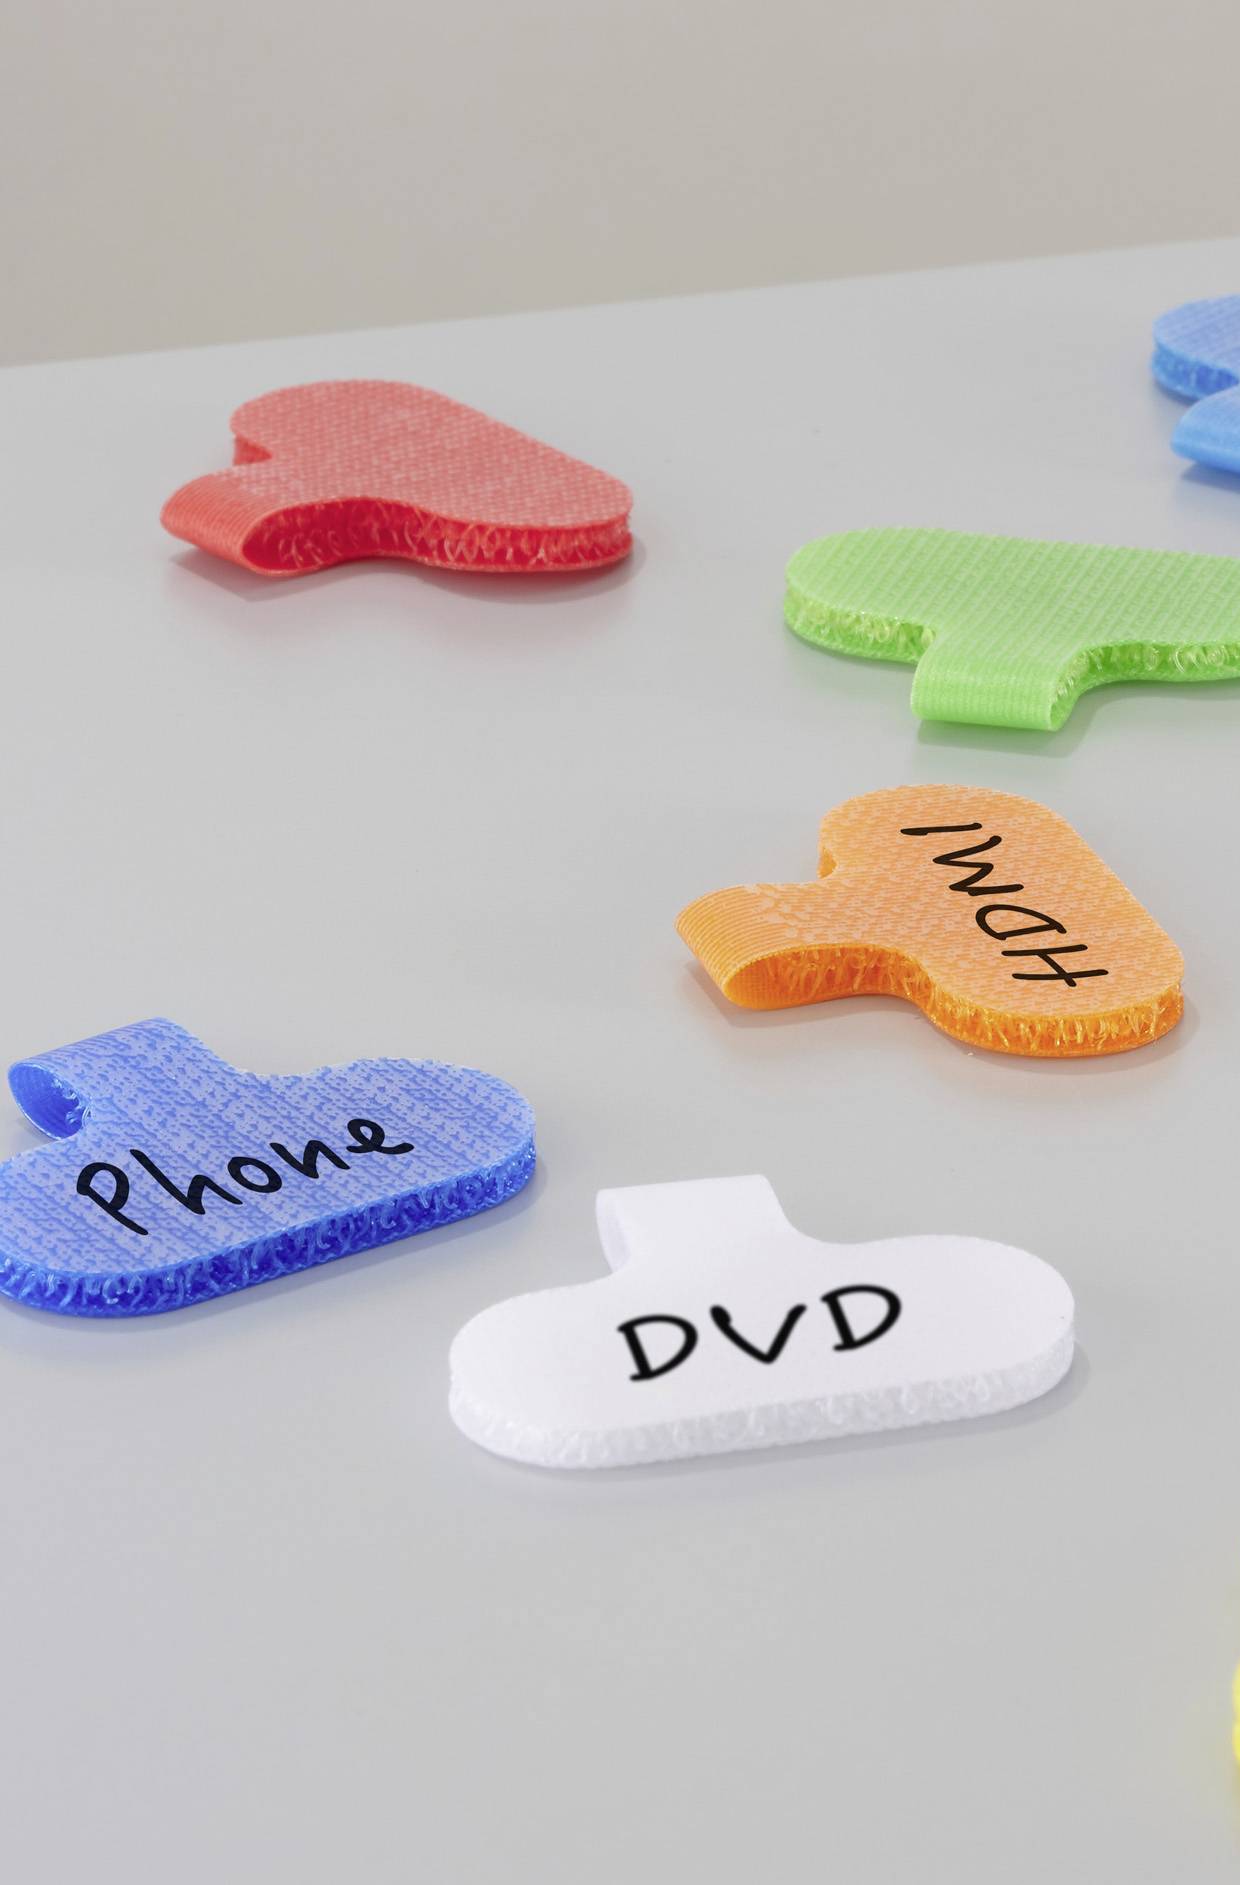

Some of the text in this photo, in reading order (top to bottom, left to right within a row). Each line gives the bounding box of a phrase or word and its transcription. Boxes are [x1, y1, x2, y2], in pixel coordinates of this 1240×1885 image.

[900, 822, 1110, 989] HDMI
[76, 1117, 415, 1237] Phone
[618, 1285, 904, 1383] DVD
